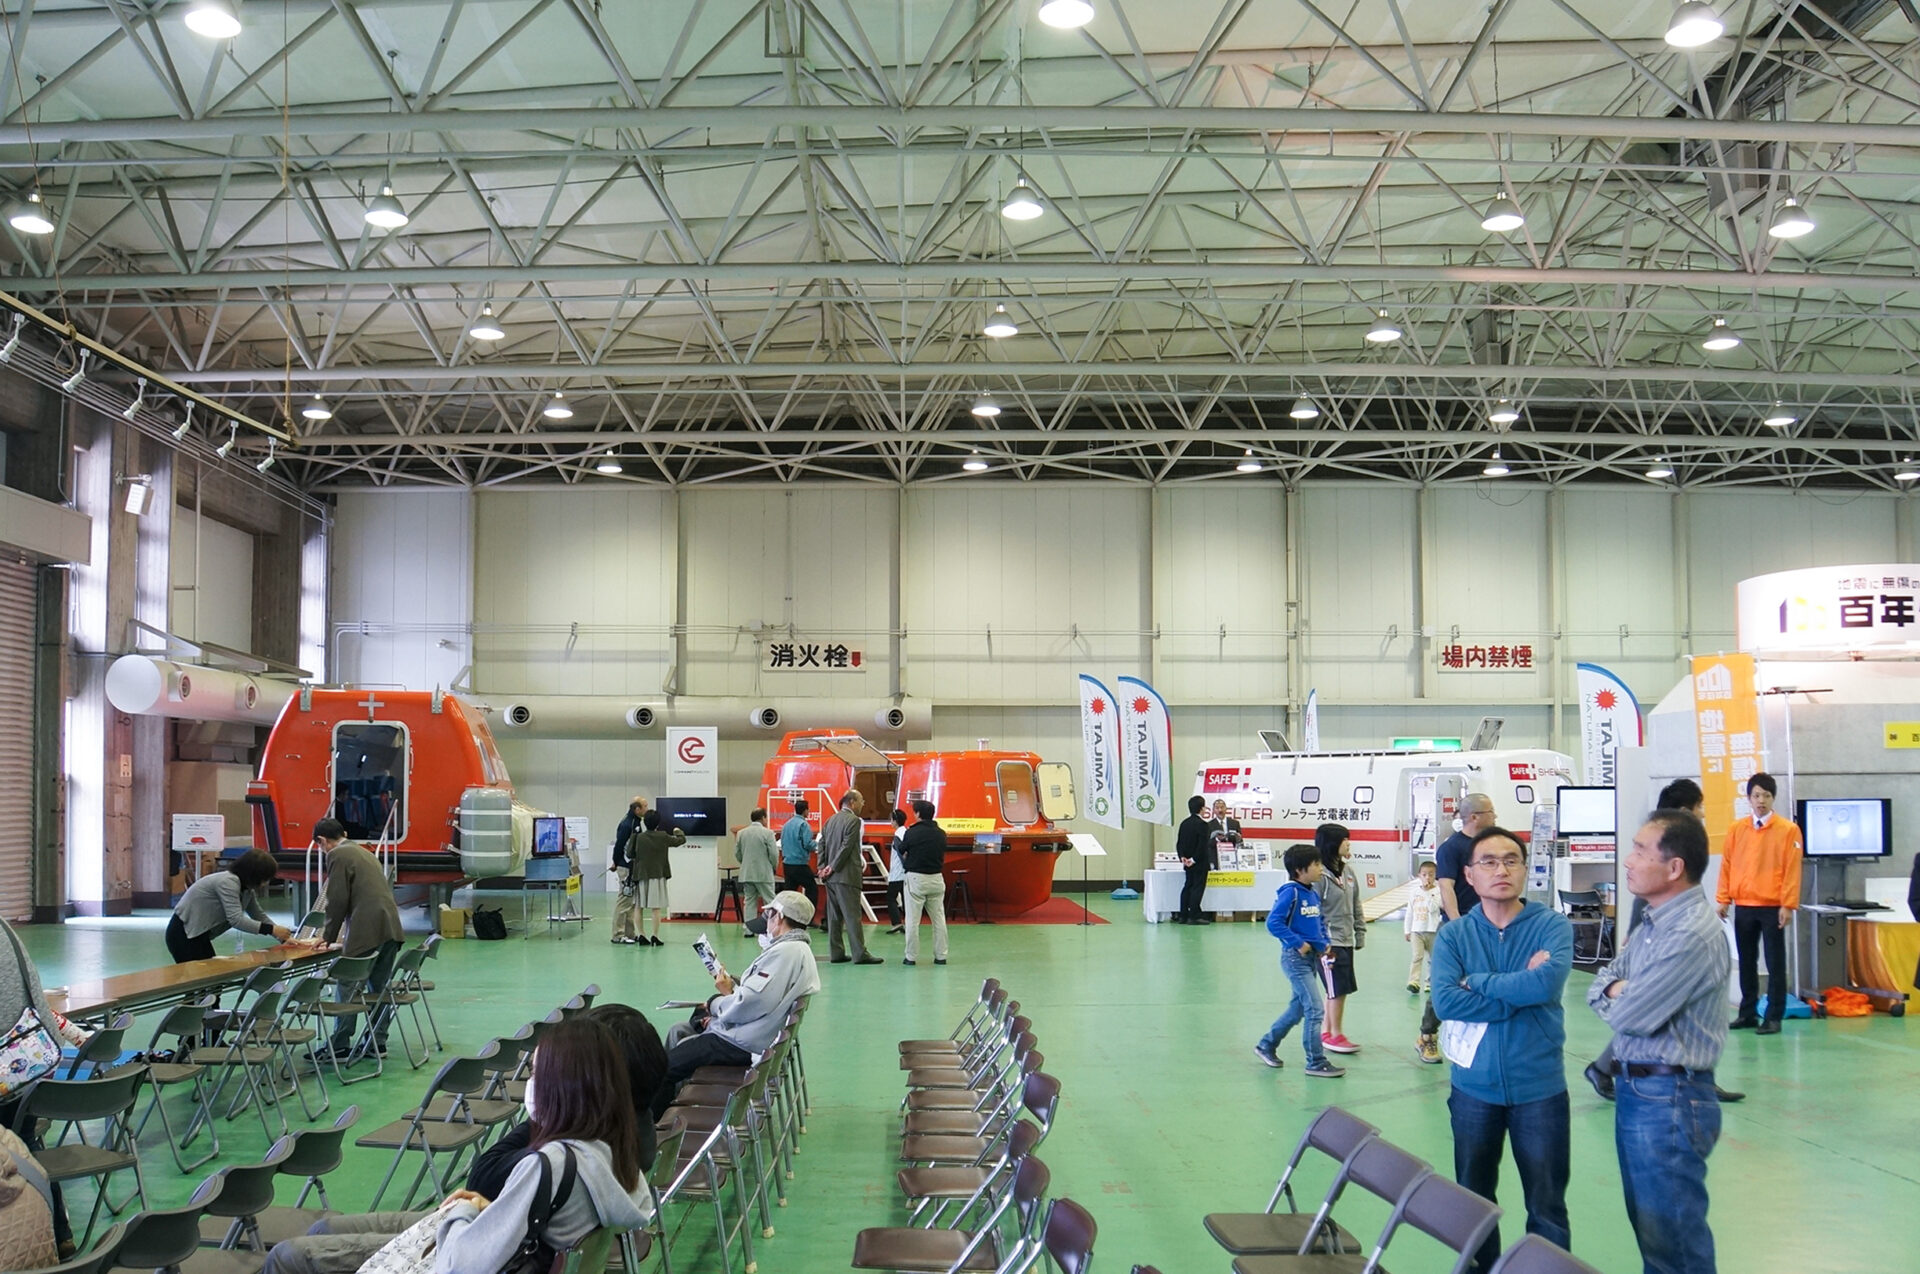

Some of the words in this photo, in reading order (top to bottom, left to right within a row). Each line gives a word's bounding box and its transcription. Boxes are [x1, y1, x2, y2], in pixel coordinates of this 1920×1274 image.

[1839, 594, 1920, 628] 百年
[770, 643, 848, 667] 消火栓
[1442, 645, 1532, 668] 場内禁煙
[1586, 693, 1594, 761] NATURAL
[1094, 722, 1104, 792] TAJIMA
[1137, 720, 1149, 790] TAJIMA
[1601, 718, 1614, 785] TAJIM
[1208, 774, 1232, 785] SAFE
[1511, 767, 1527, 775] SAFE
[1282, 807, 1371, 821] ソーラー充電装置付
